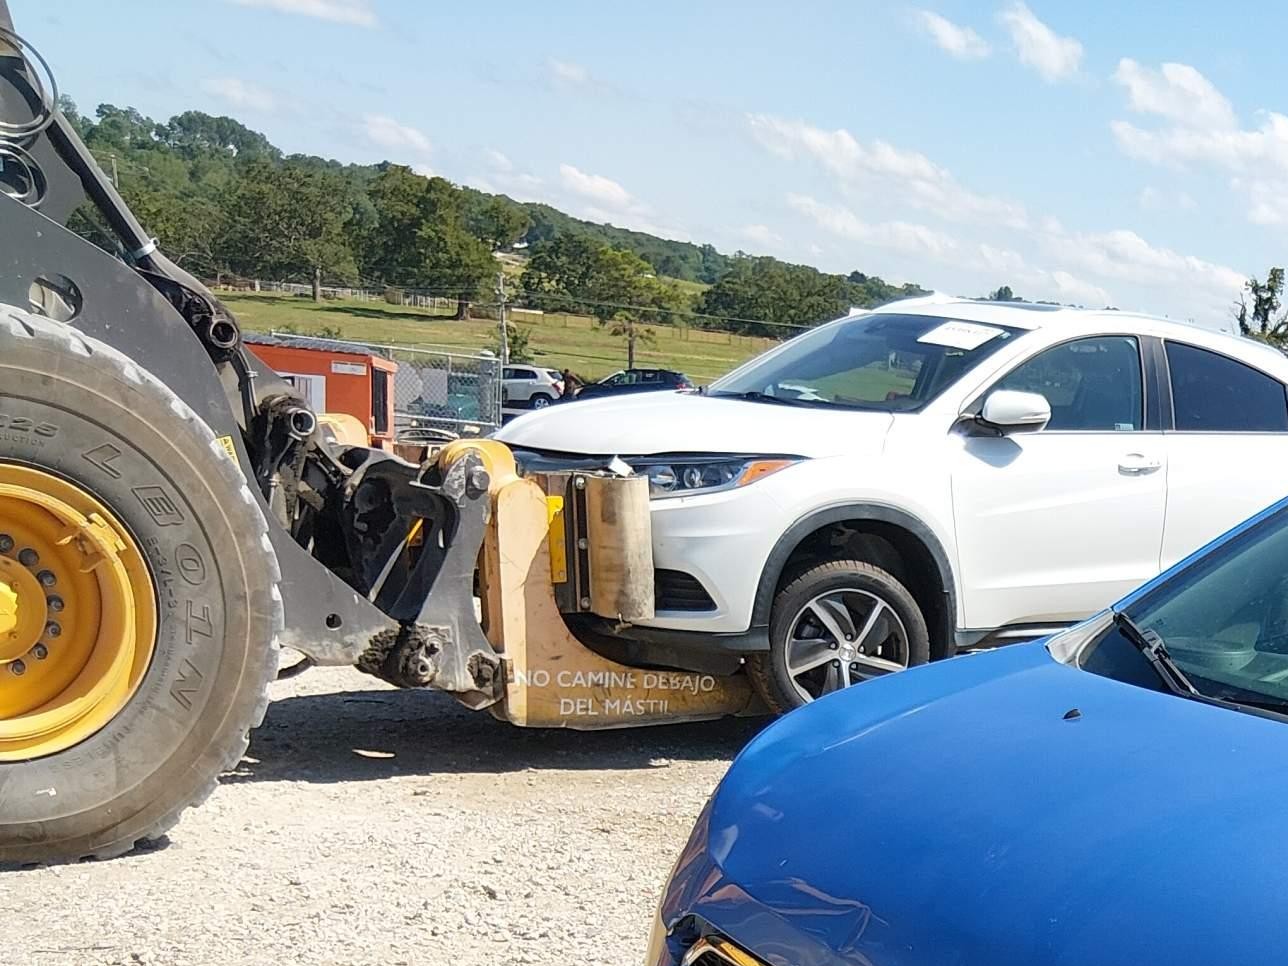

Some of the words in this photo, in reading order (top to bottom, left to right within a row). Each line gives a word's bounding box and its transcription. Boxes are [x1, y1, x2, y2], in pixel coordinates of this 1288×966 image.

[515, 670, 550, 687] NO
[556, 671, 637, 689] CAMINE
[643, 673, 716, 696] DEBAJO
[560, 699, 598, 716] DEL
[604, 695, 672, 716] MÁSTIL
